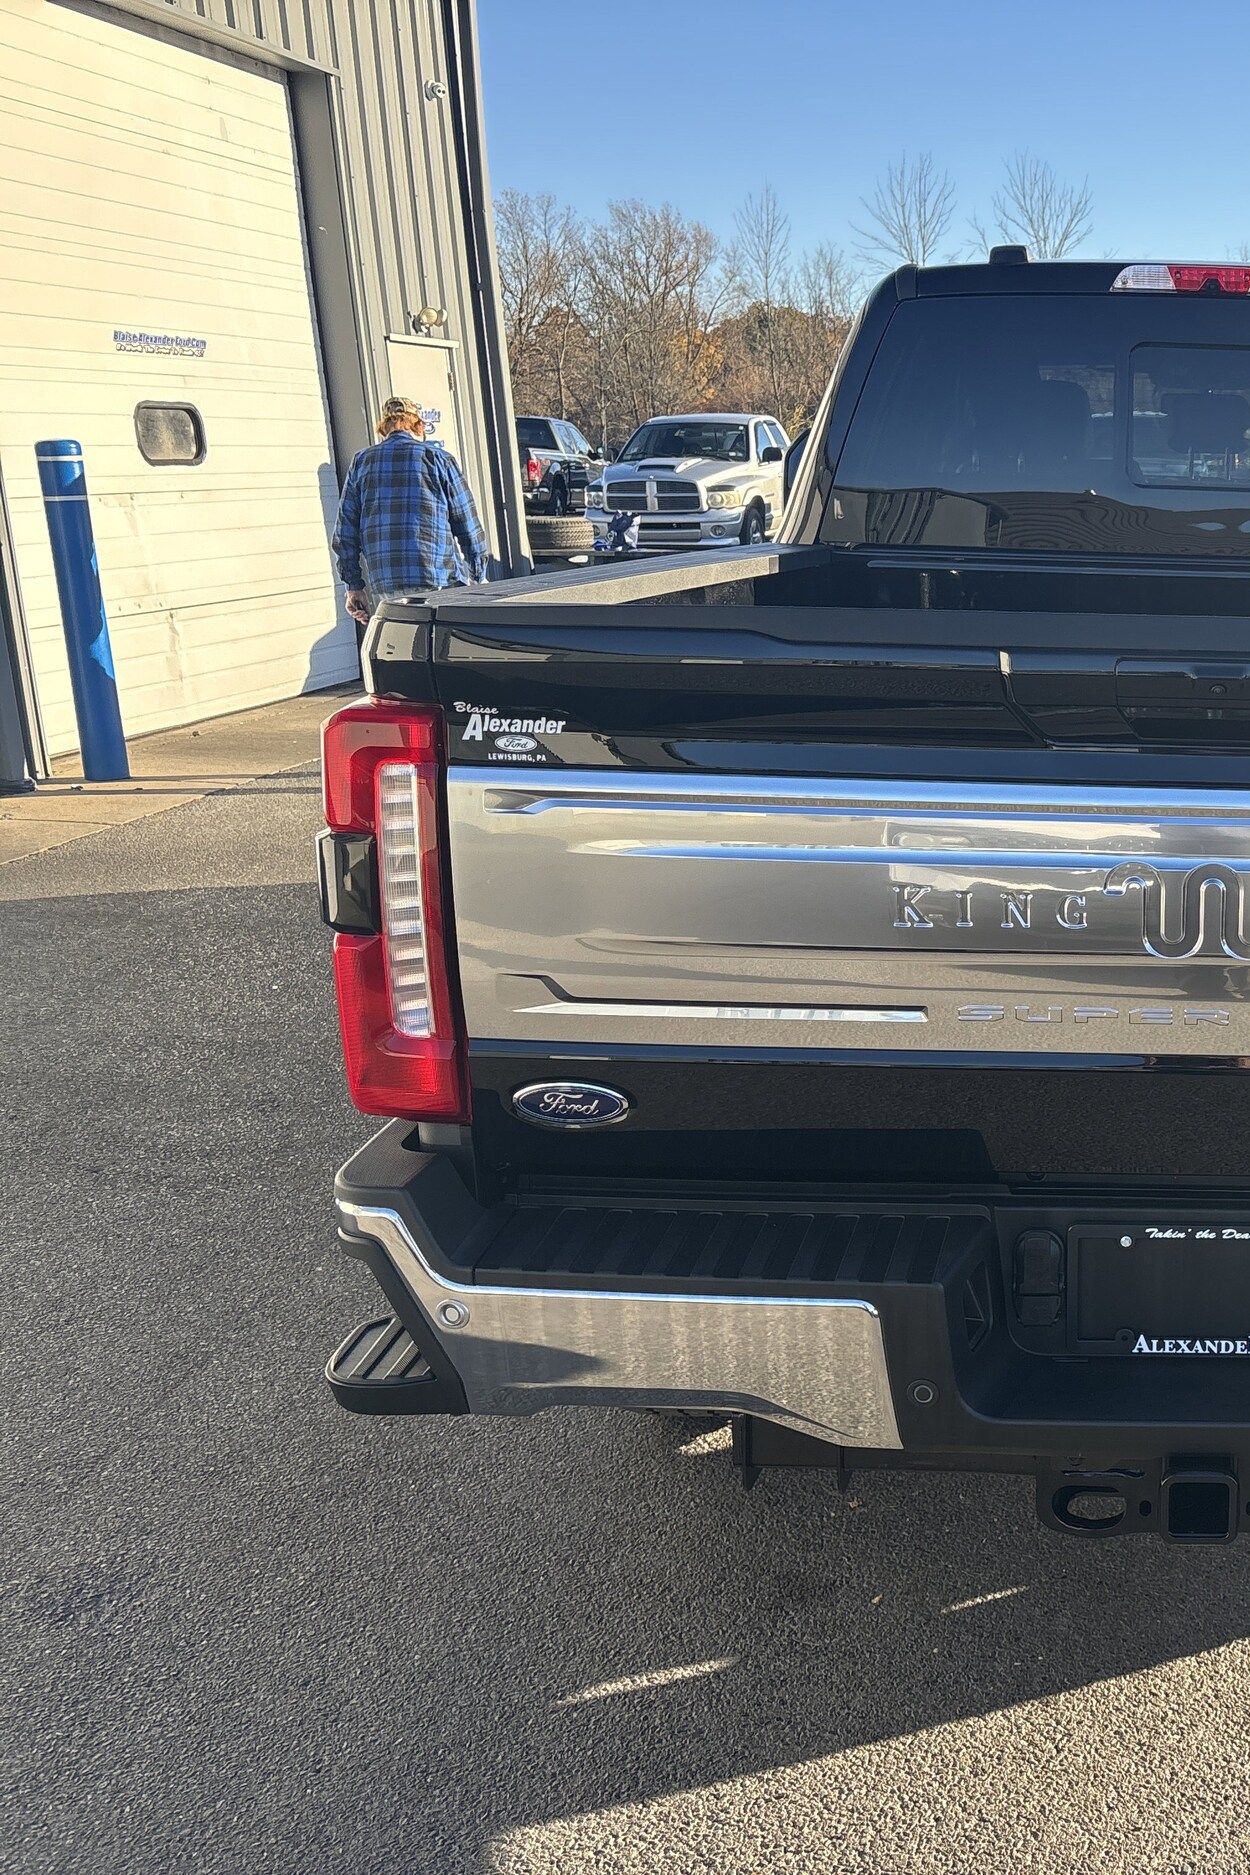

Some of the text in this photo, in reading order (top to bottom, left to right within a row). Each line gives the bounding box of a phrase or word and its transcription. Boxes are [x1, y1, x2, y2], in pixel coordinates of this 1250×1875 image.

[453, 701, 499, 714] Blaise
[461, 714, 567, 741] Alexander
[503, 737, 529, 749] Ford
[488, 752, 547, 763] LEWISBURG, PA
[892, 885, 1089, 930] KING
[957, 1004, 1230, 1026] SUPER
[538, 1091, 601, 1116] Ford
[1144, 1227, 1192, 1239] Takin'
[1194, 1228, 1217, 1239] the
